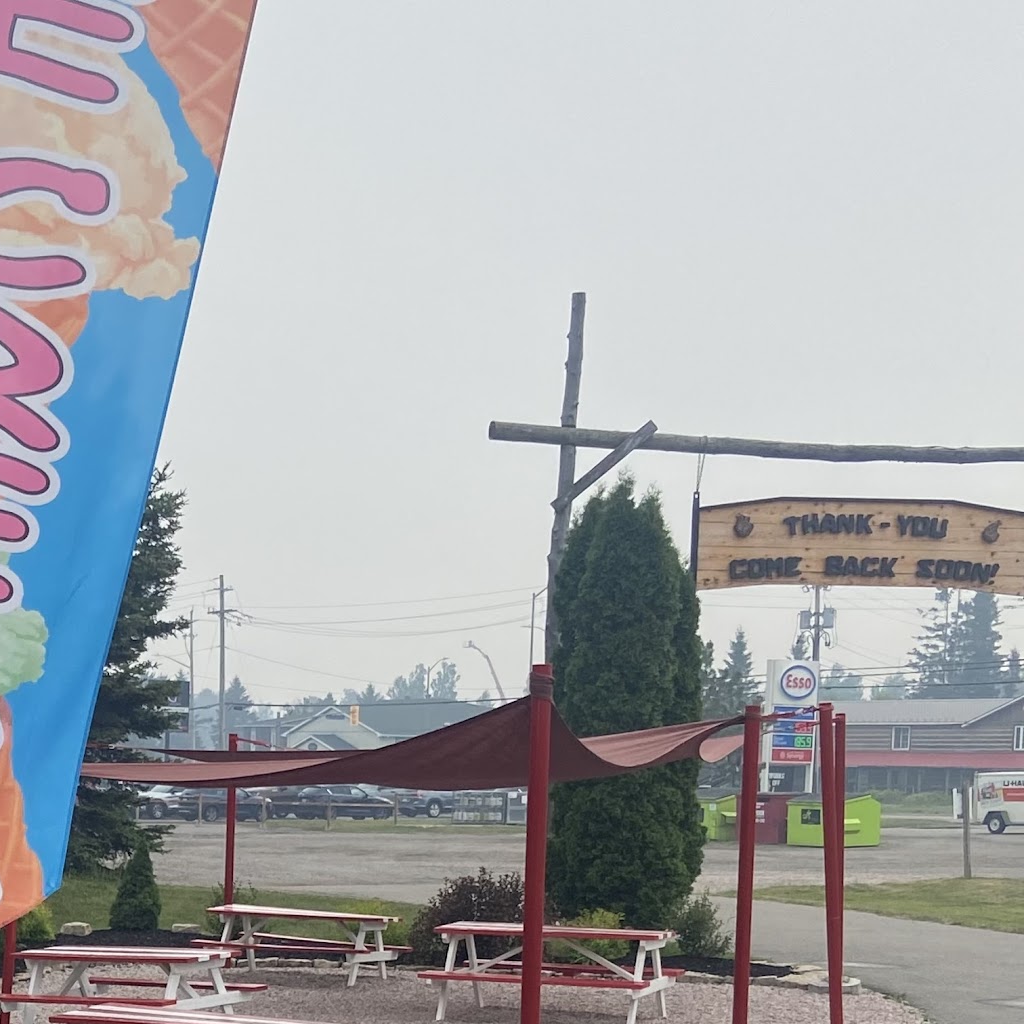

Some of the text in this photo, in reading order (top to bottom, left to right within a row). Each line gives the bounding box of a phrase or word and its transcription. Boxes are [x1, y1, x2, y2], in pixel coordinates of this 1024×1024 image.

[728, 555, 1000, 585] COME BACK SOON!
